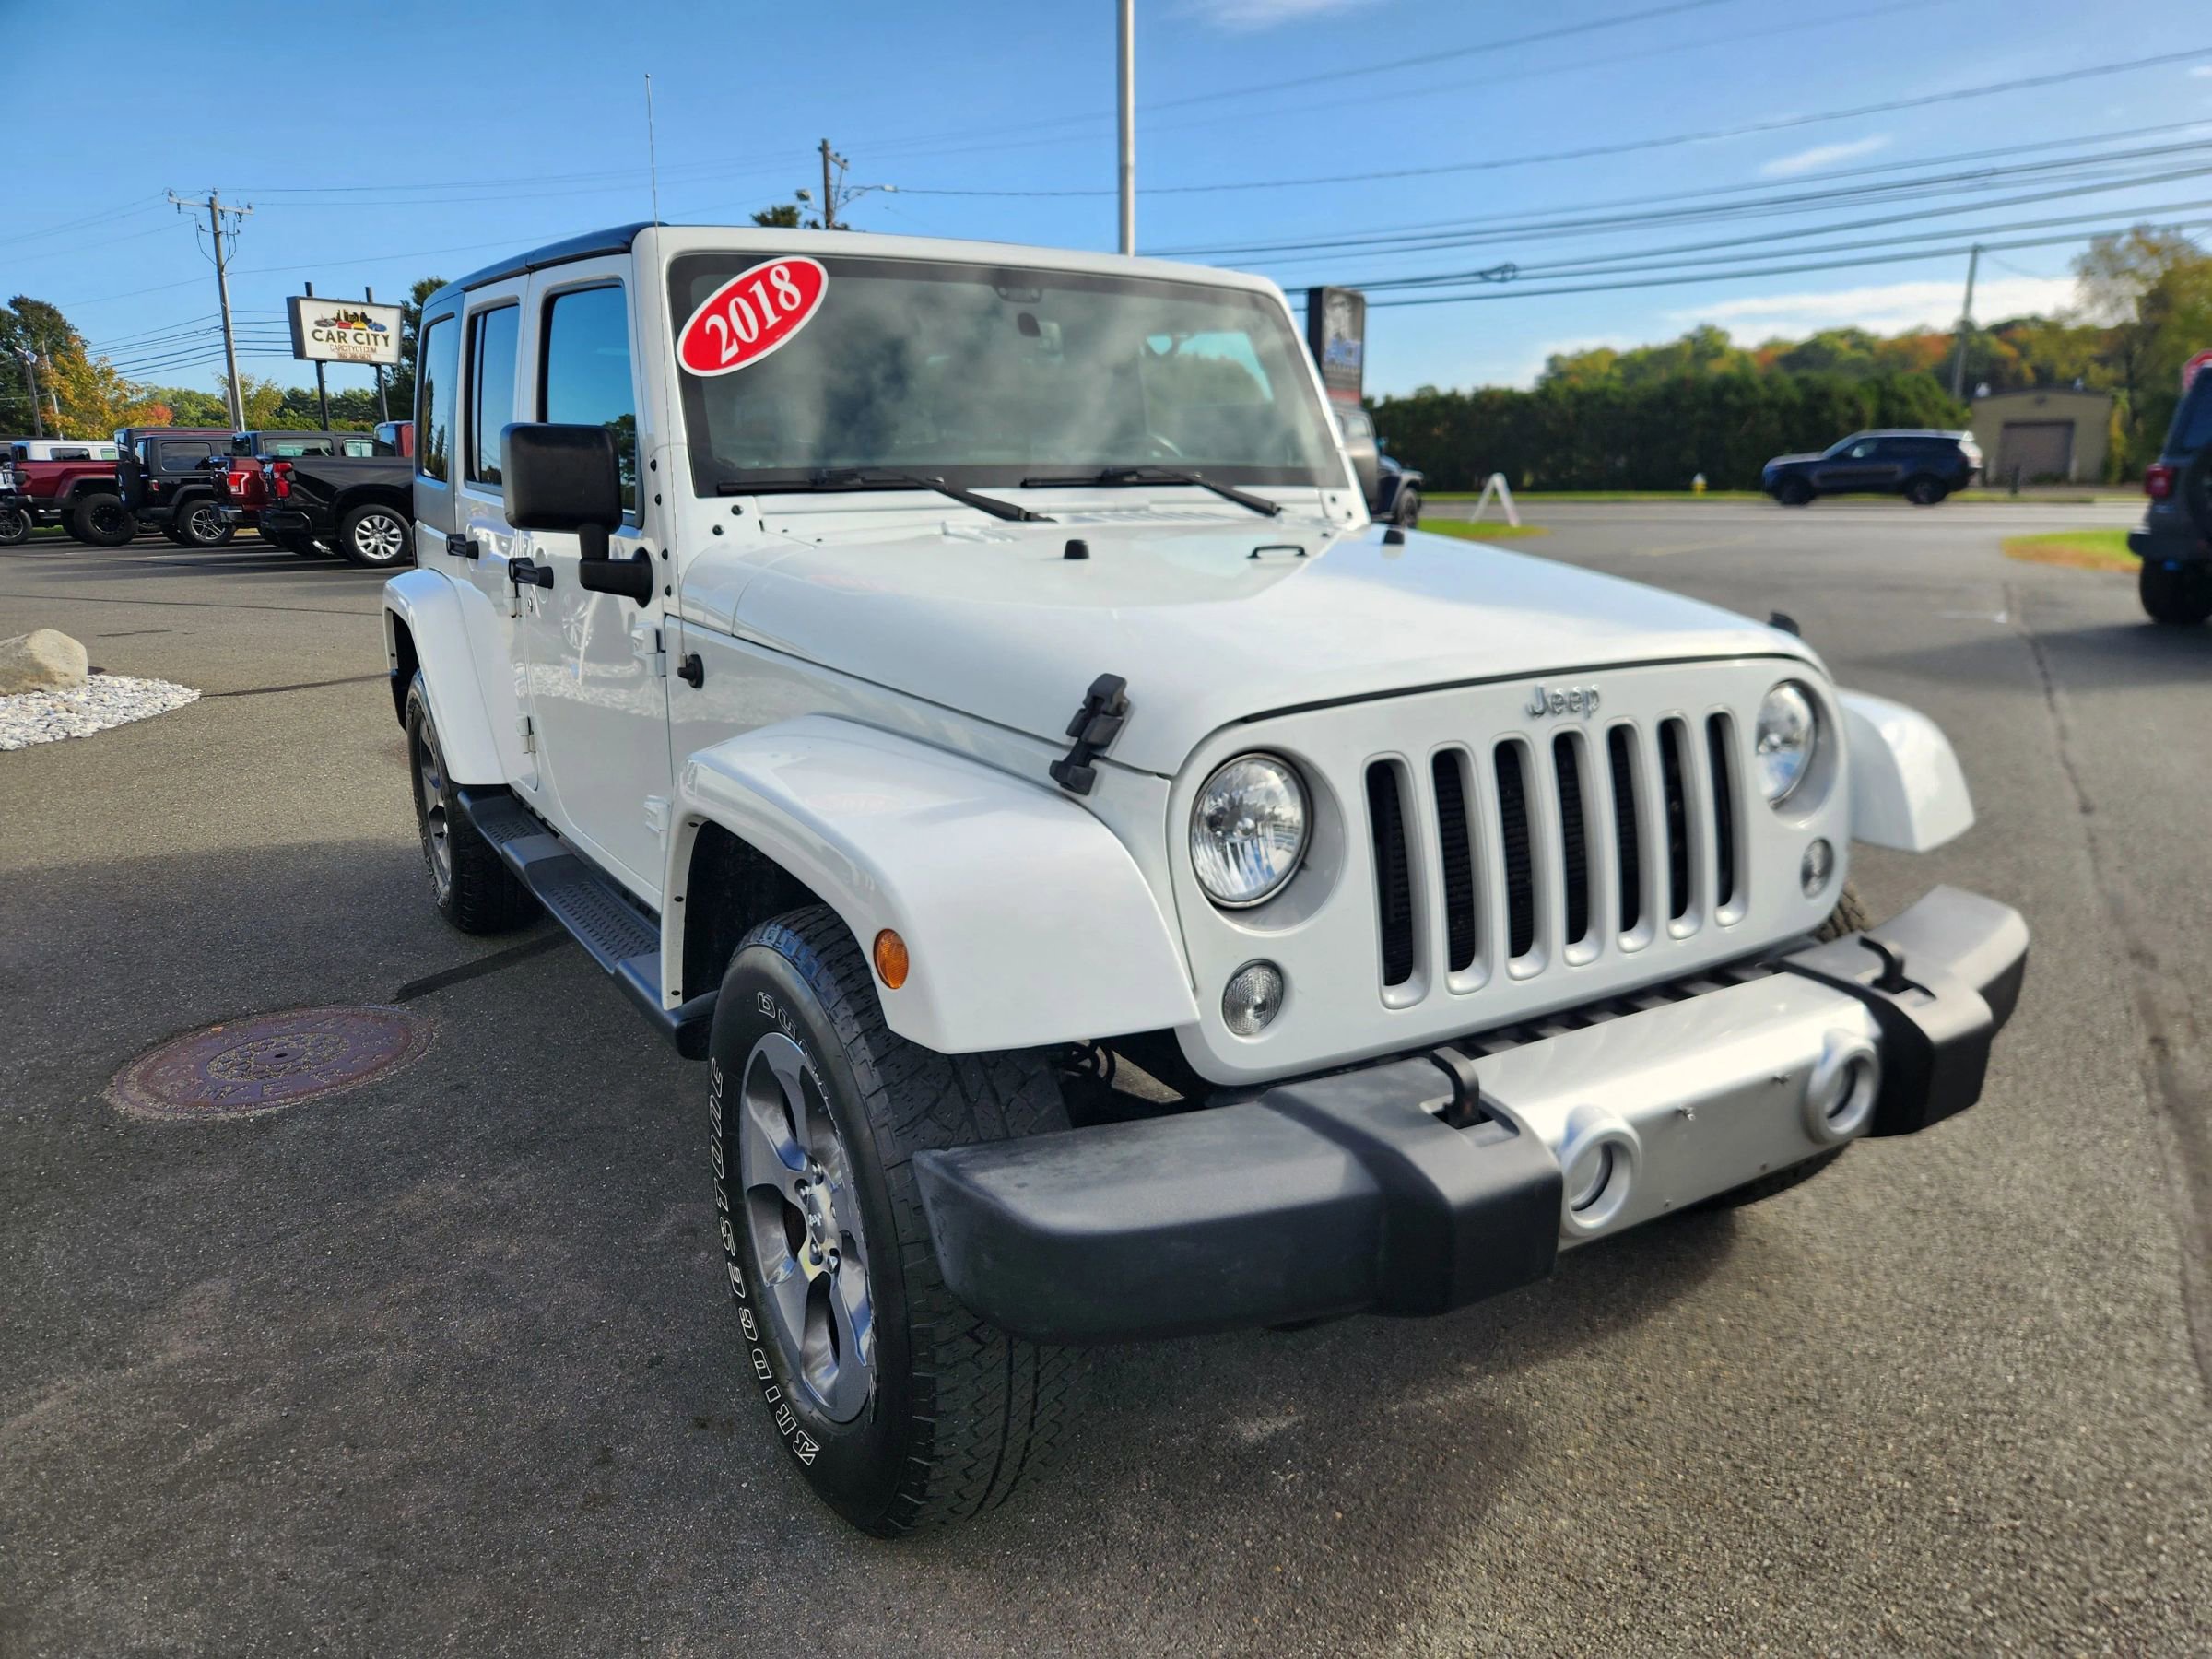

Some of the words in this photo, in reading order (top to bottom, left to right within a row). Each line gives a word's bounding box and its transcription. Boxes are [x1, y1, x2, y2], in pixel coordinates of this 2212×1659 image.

[312, 329, 347, 344] CAR
[353, 332, 391, 347] CITY
[705, 265, 802, 365] 2018
[1527, 682, 1601, 719] Jeep
[710, 1057, 821, 1466] BRIDGESTONE
